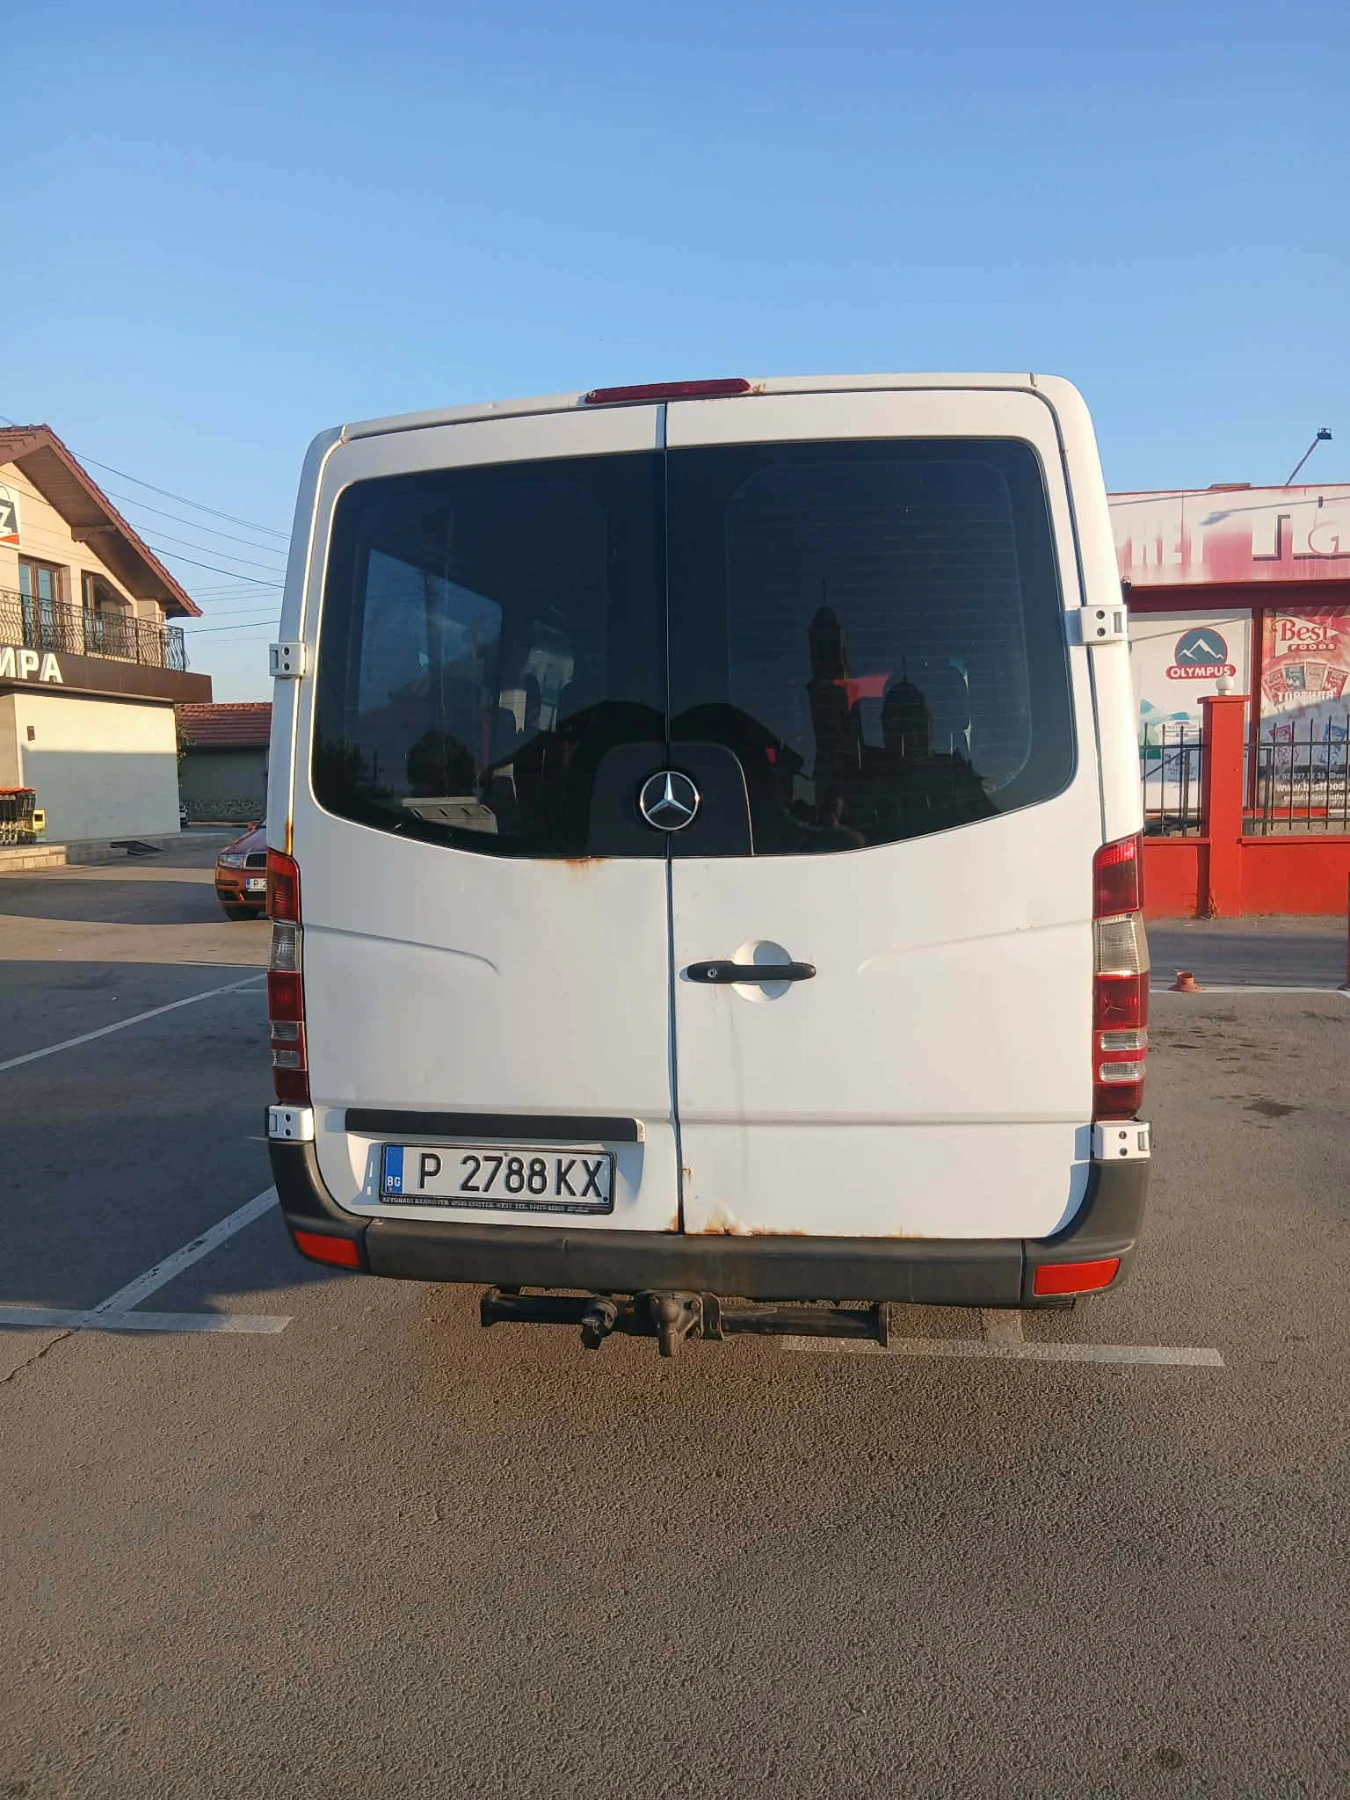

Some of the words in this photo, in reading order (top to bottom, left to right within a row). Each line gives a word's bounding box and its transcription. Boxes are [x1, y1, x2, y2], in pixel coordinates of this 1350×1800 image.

[1270, 619, 1329, 641] Best
[1291, 643, 1336, 651] FOODS
[1170, 666, 1231, 677] OLYMPUS
[419, 1153, 442, 1189] P
[460, 1155, 547, 1193] 2788
[556, 1159, 603, 1197] KX
[387, 1176, 401, 1187] BG
